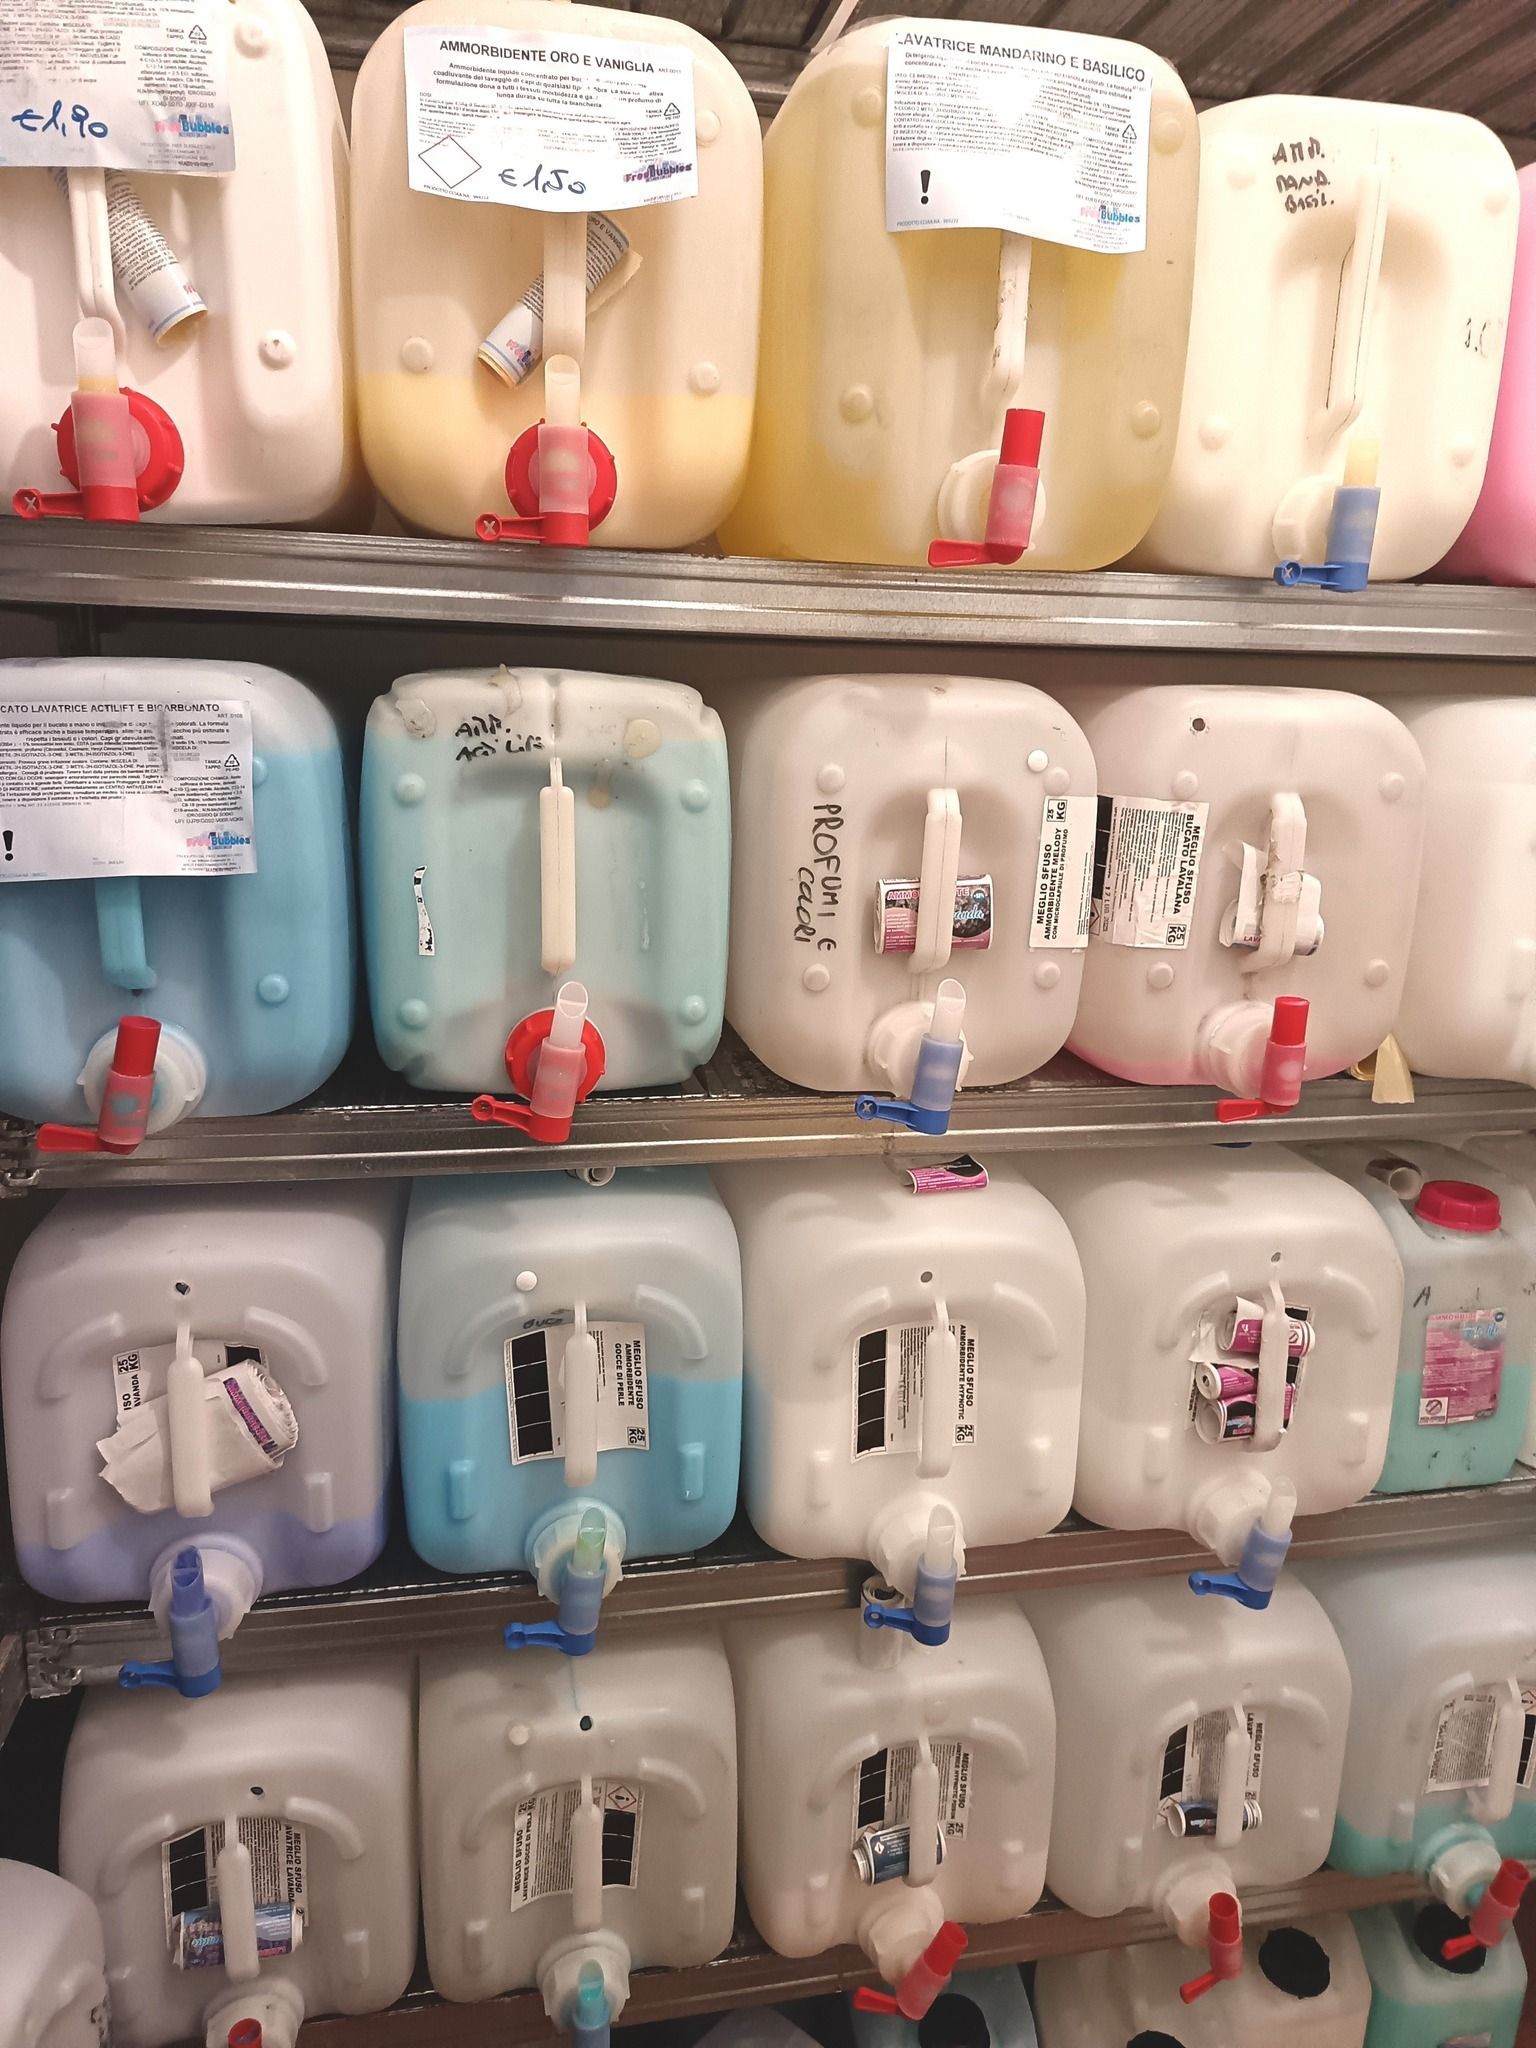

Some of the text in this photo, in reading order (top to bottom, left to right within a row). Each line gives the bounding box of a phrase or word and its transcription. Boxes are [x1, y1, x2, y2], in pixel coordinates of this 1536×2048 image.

[440, 40, 654, 73] AMMORBIDENTE ORO E VANIGLIA
[450, 62, 496, 74] Ammorbidente
[980, 44, 1066, 66] MANDARINO
[1070, 56, 1079, 68] E
[1083, 58, 1145, 82] BASILICO
[569, 100, 602, 108] biancheria
[0, 705, 28, 713] CATO
[32, 704, 88, 713] LAVATRICE
[91, 704, 134, 712] ACTILIFT
[147, 704, 220, 712] BICARBONATO
[1047, 809, 1054, 819] 25
[1056, 802, 1066, 820] KG
[812, 804, 844, 917] PROFUMI
[1173, 814, 1194, 915] BUCATO LAVALANA
[1183, 826, 1200, 904] MEGLIO SFUSO
[1037, 844, 1052, 924] MEGLIO SFUSO
[1044, 828, 1062, 940] AMMORBIDENTE MELODY
[1053, 873, 1064, 923] MICROCAPSULE
[1060, 829, 1068, 862] PROFUMO
[1167, 926, 1177, 943] KG
[1177, 926, 1186, 940] 25
[118, 1359, 128, 1373] 25
[128, 1353, 138, 1370] KG
[615, 1343, 623, 1370] GOCCE
[966, 1339, 975, 1374] MEGLIO
[625, 1344, 634, 1406] AMMORBIDENTE
[633, 1340, 643, 1410] MEGLIO SFUSO
[123, 1393, 132, 1410] ISO
[132, 1374, 142, 1407] AVANDA
[629, 1428, 637, 1444] KG
[637, 1429, 645, 1441] 25
[957, 1426, 965, 1441] KG
[965, 1425, 973, 1437] 25
[1254, 1723, 1263, 1751] MEGLIO
[958, 1753, 969, 1808] MEGLIO SFUSO
[285, 1825, 293, 1865] AVATRICE
[294, 1832, 302, 1894] MEGLIO SFUSO
